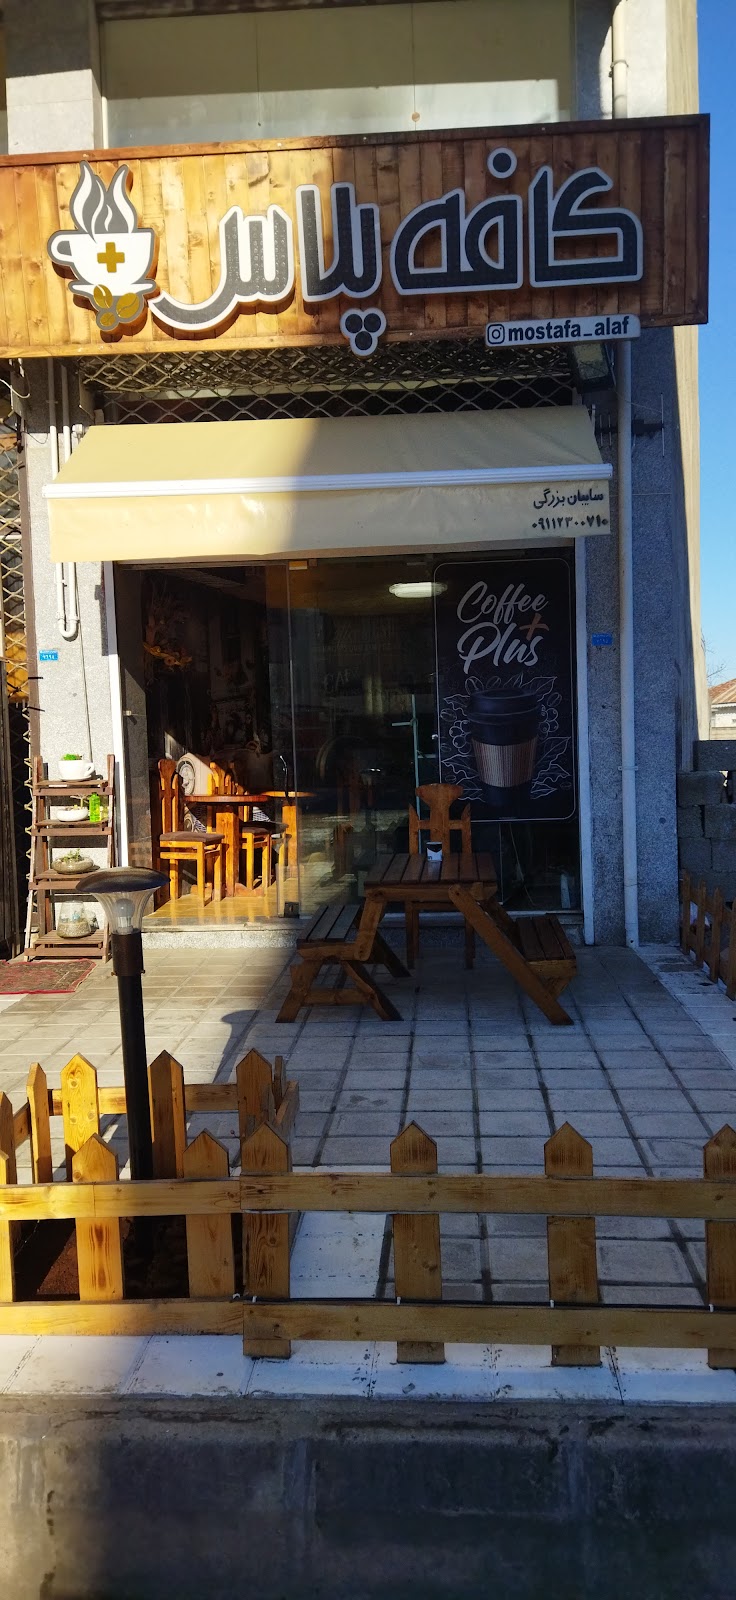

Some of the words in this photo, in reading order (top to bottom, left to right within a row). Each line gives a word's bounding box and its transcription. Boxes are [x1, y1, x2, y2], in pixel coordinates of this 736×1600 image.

[391, 148, 642, 293] کافه
[151, 183, 386, 355] پلاس
[508, 316, 630, 342] mostafa_alaf
[533, 488, 565, 509] بزرگی
[567, 488, 604, 506] سایبان
[457, 581, 549, 625] Coffee
[456, 622, 545, 675] Plus
